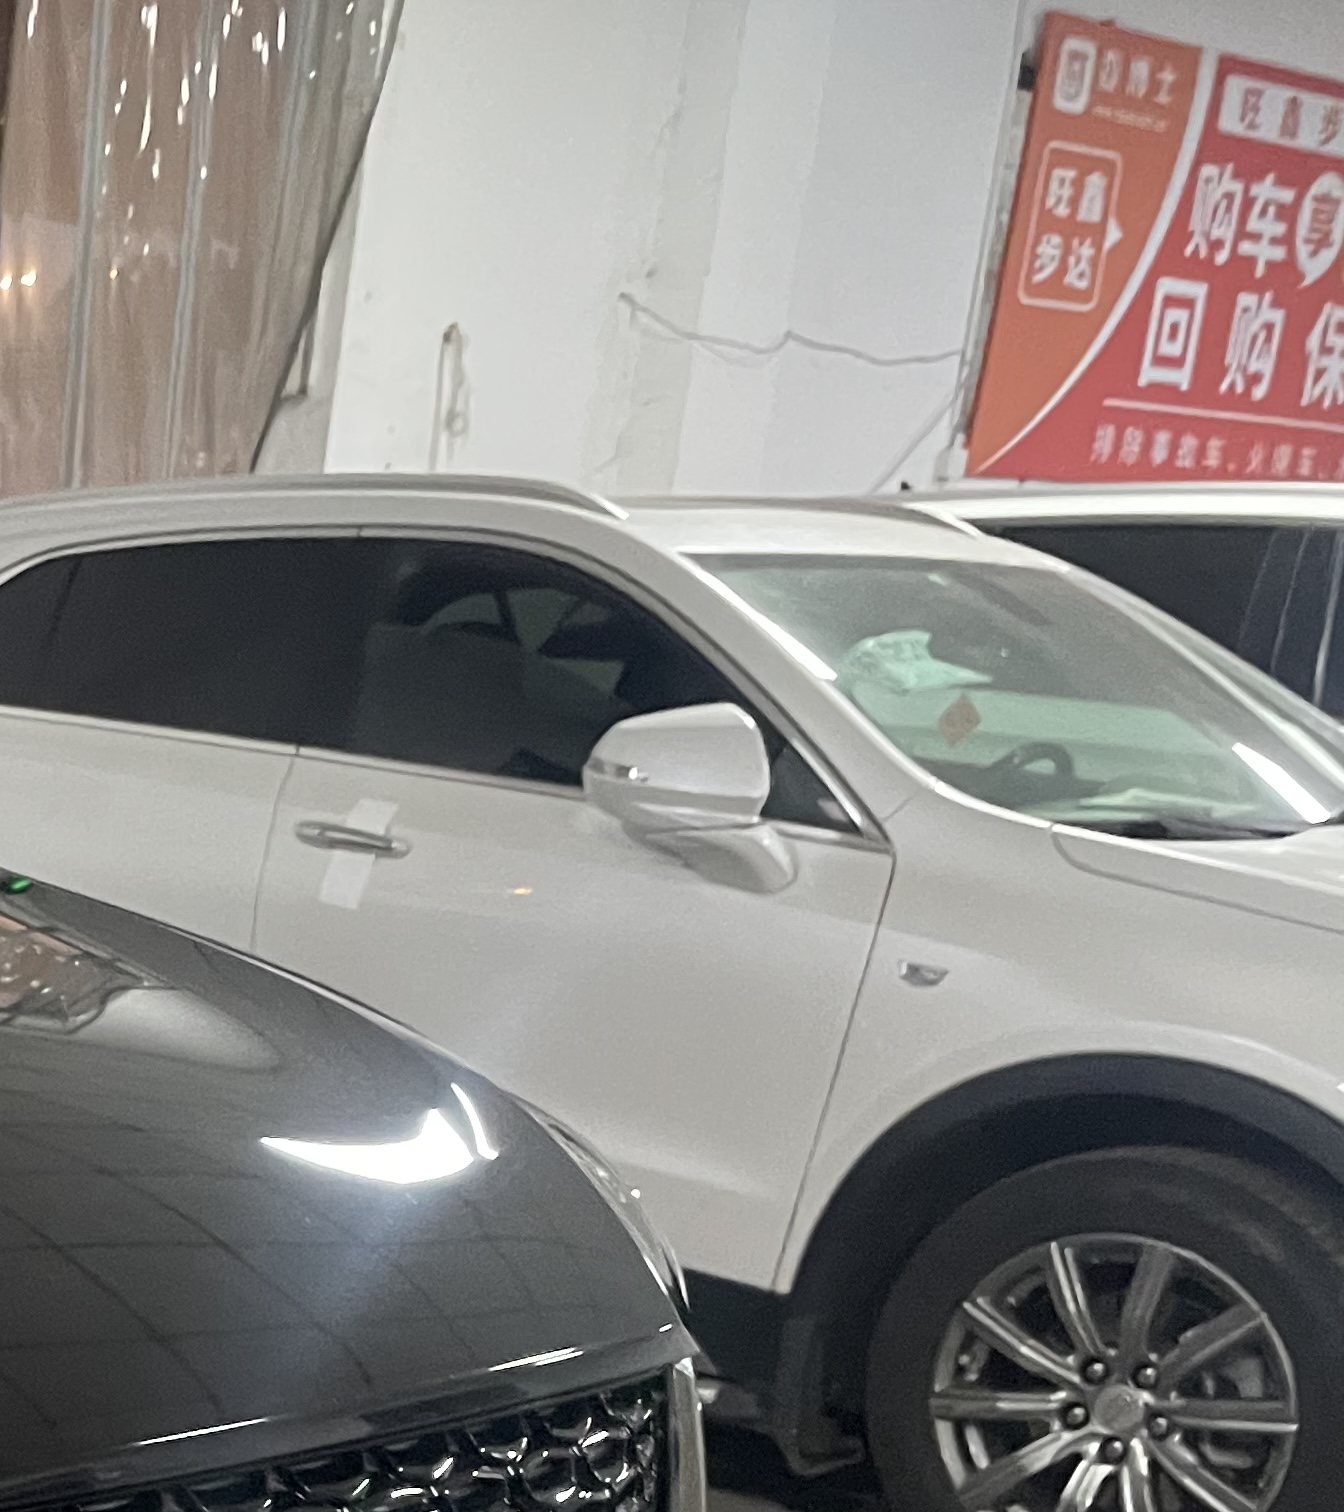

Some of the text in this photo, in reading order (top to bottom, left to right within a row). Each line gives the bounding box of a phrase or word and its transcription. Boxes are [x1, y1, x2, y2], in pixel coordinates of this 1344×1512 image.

[1184, 162, 1343, 278] 购车享
[1138, 276, 1344, 409] 回购保
